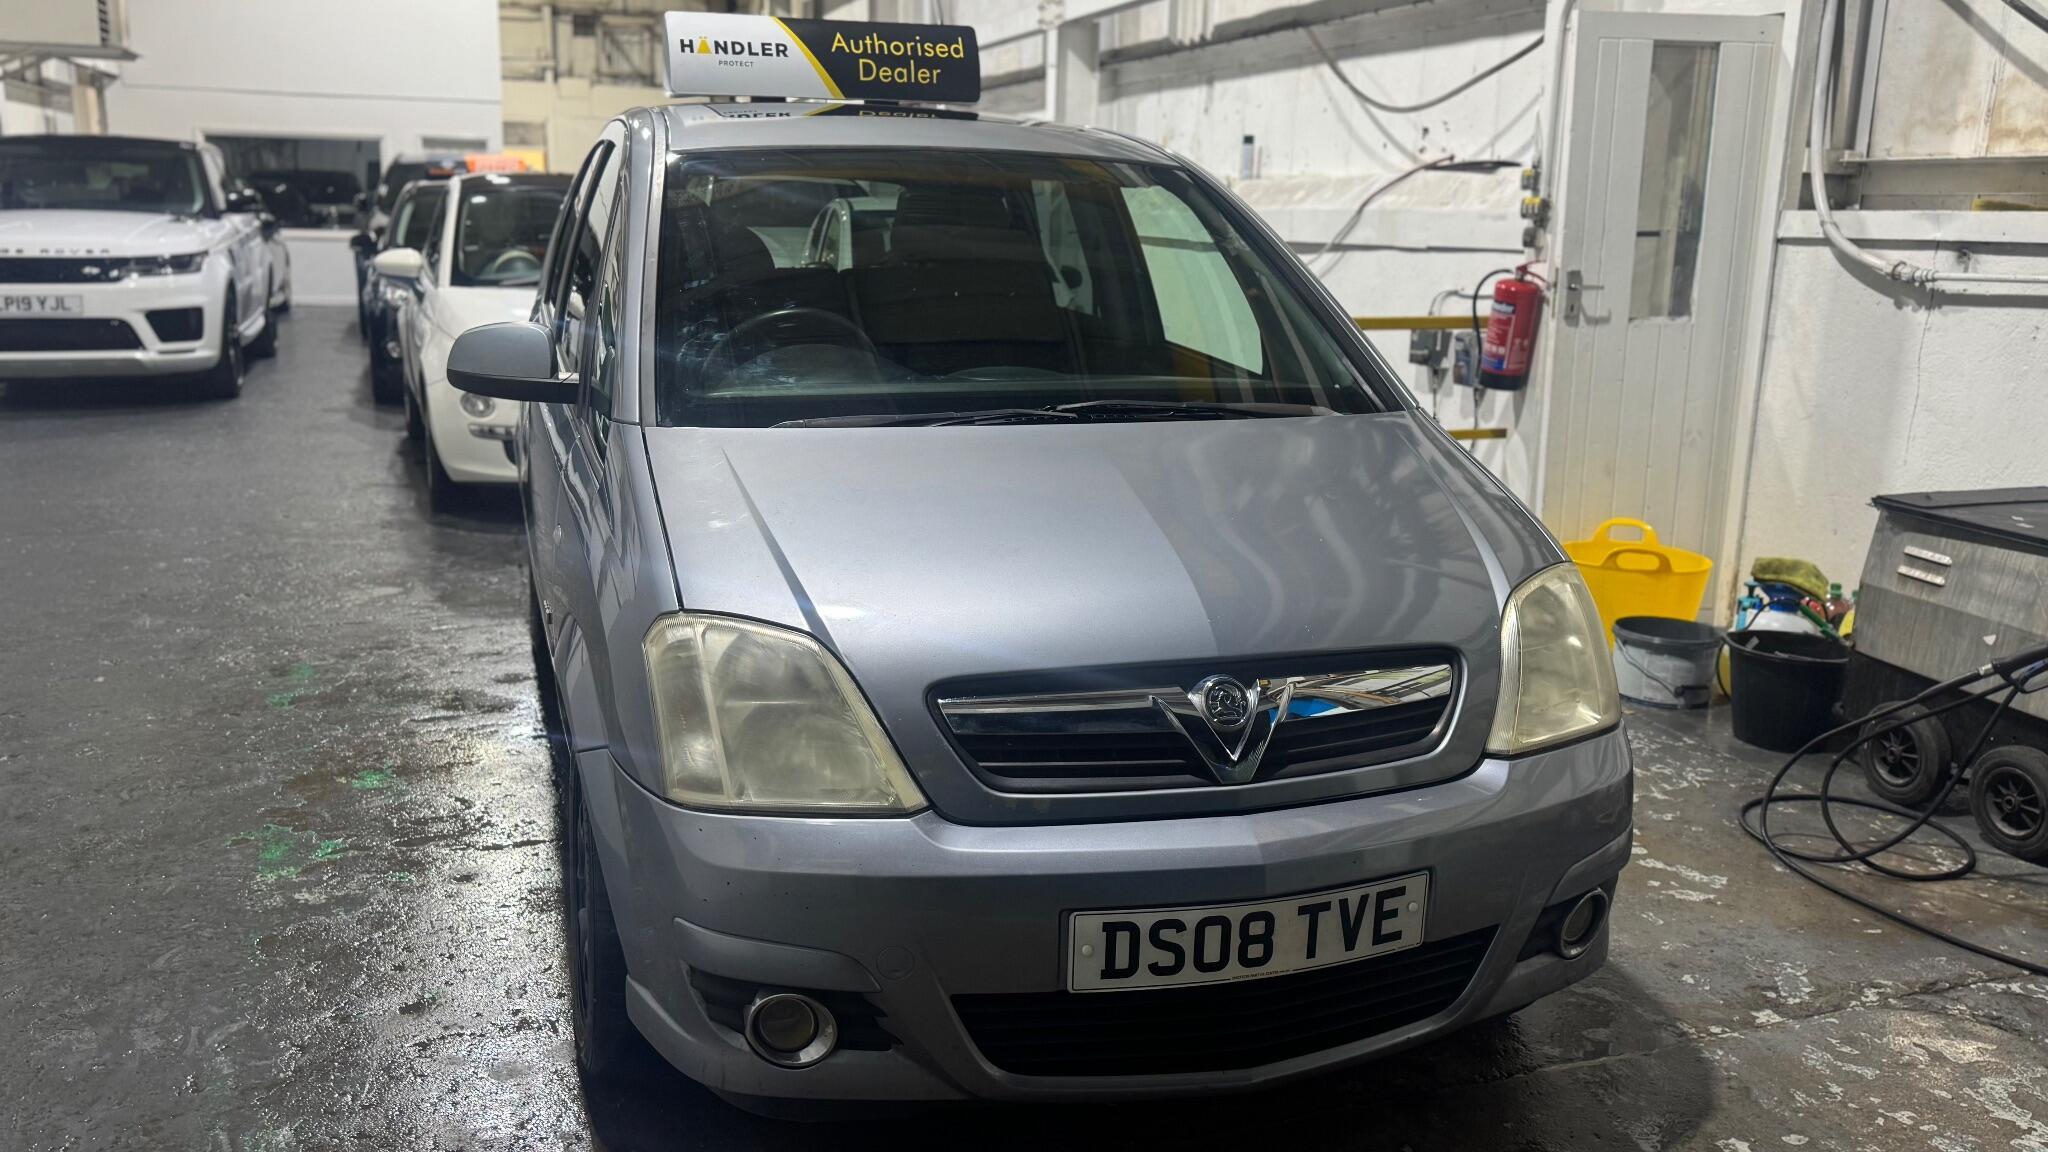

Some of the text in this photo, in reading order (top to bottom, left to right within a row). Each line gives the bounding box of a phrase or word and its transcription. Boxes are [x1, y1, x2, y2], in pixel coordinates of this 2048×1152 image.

[679, 36, 789, 58] HÄNDLER
[831, 32, 964, 58] Authorised
[718, 60, 754, 68] PROTECT
[859, 58, 941, 84] Dealer
[36, 295, 72, 312] YJL
[1100, 885, 1407, 980] DS08 TVE
